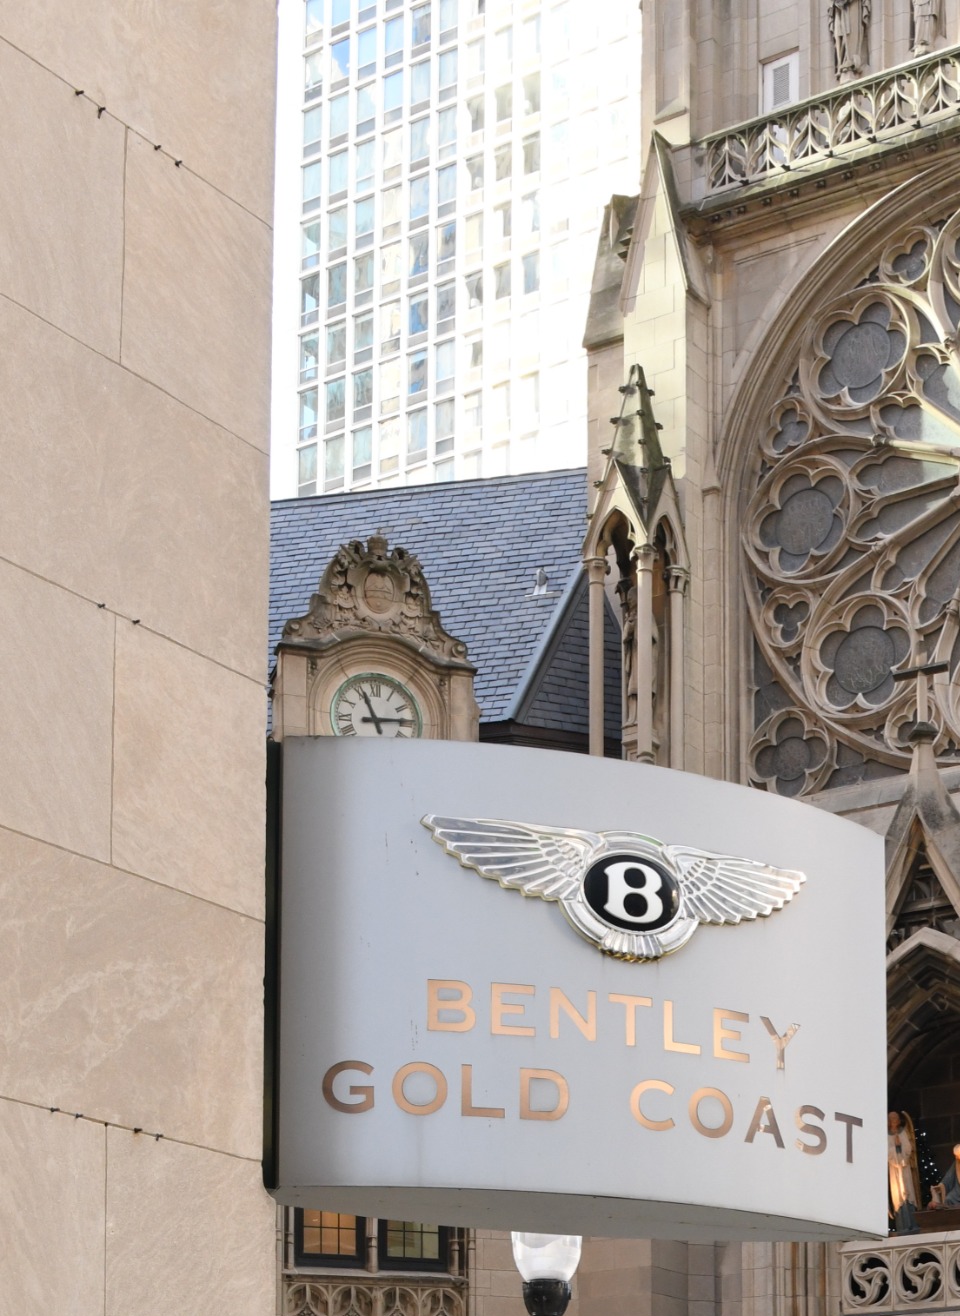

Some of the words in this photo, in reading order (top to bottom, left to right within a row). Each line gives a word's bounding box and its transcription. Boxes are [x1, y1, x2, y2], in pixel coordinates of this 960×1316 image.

[369, 684, 381, 698] XII
[602, 861, 664, 923] B
[426, 978, 801, 1071] BENTLEY
[321, 1059, 570, 1122] GOLD
[629, 1079, 864, 1164] COAST
